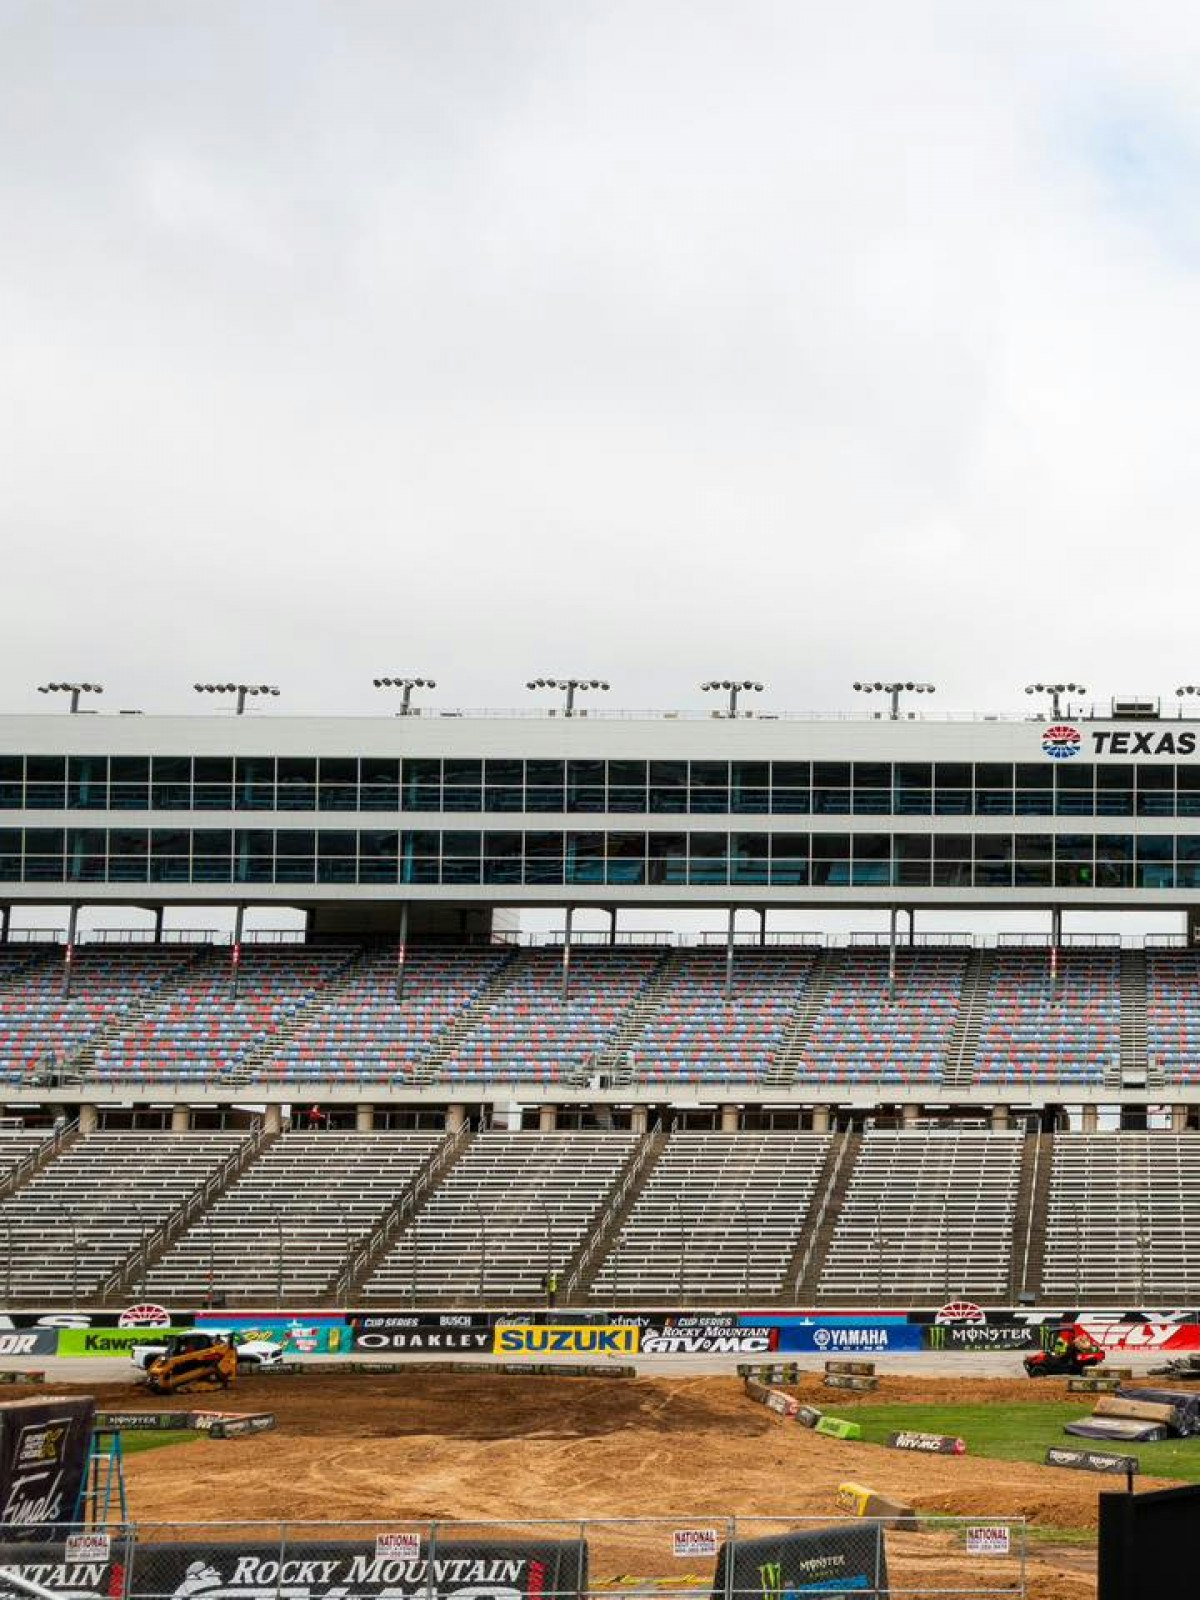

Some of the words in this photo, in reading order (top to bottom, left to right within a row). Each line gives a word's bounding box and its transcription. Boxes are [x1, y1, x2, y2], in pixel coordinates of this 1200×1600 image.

[1092, 731, 1197, 755] TEXAS
[440, 1315, 472, 1326] BUSCH
[662, 1326, 703, 1337] ROCKY
[703, 1326, 770, 1337] MOUNTAIN
[830, 1329, 888, 1346] YAMAHA
[952, 1327, 1032, 1341] MONSTER
[393, 1334, 487, 1347] OAKLEY
[501, 1330, 632, 1351] SUZUKI
[378, 1534, 418, 1546] NATIONAL
[675, 1530, 716, 1543] NATIONAL
[967, 1528, 1008, 1540] NATIONAL
[228, 1556, 342, 1584] ROCKY
[342, 1556, 527, 1584] MOUNTAIN
